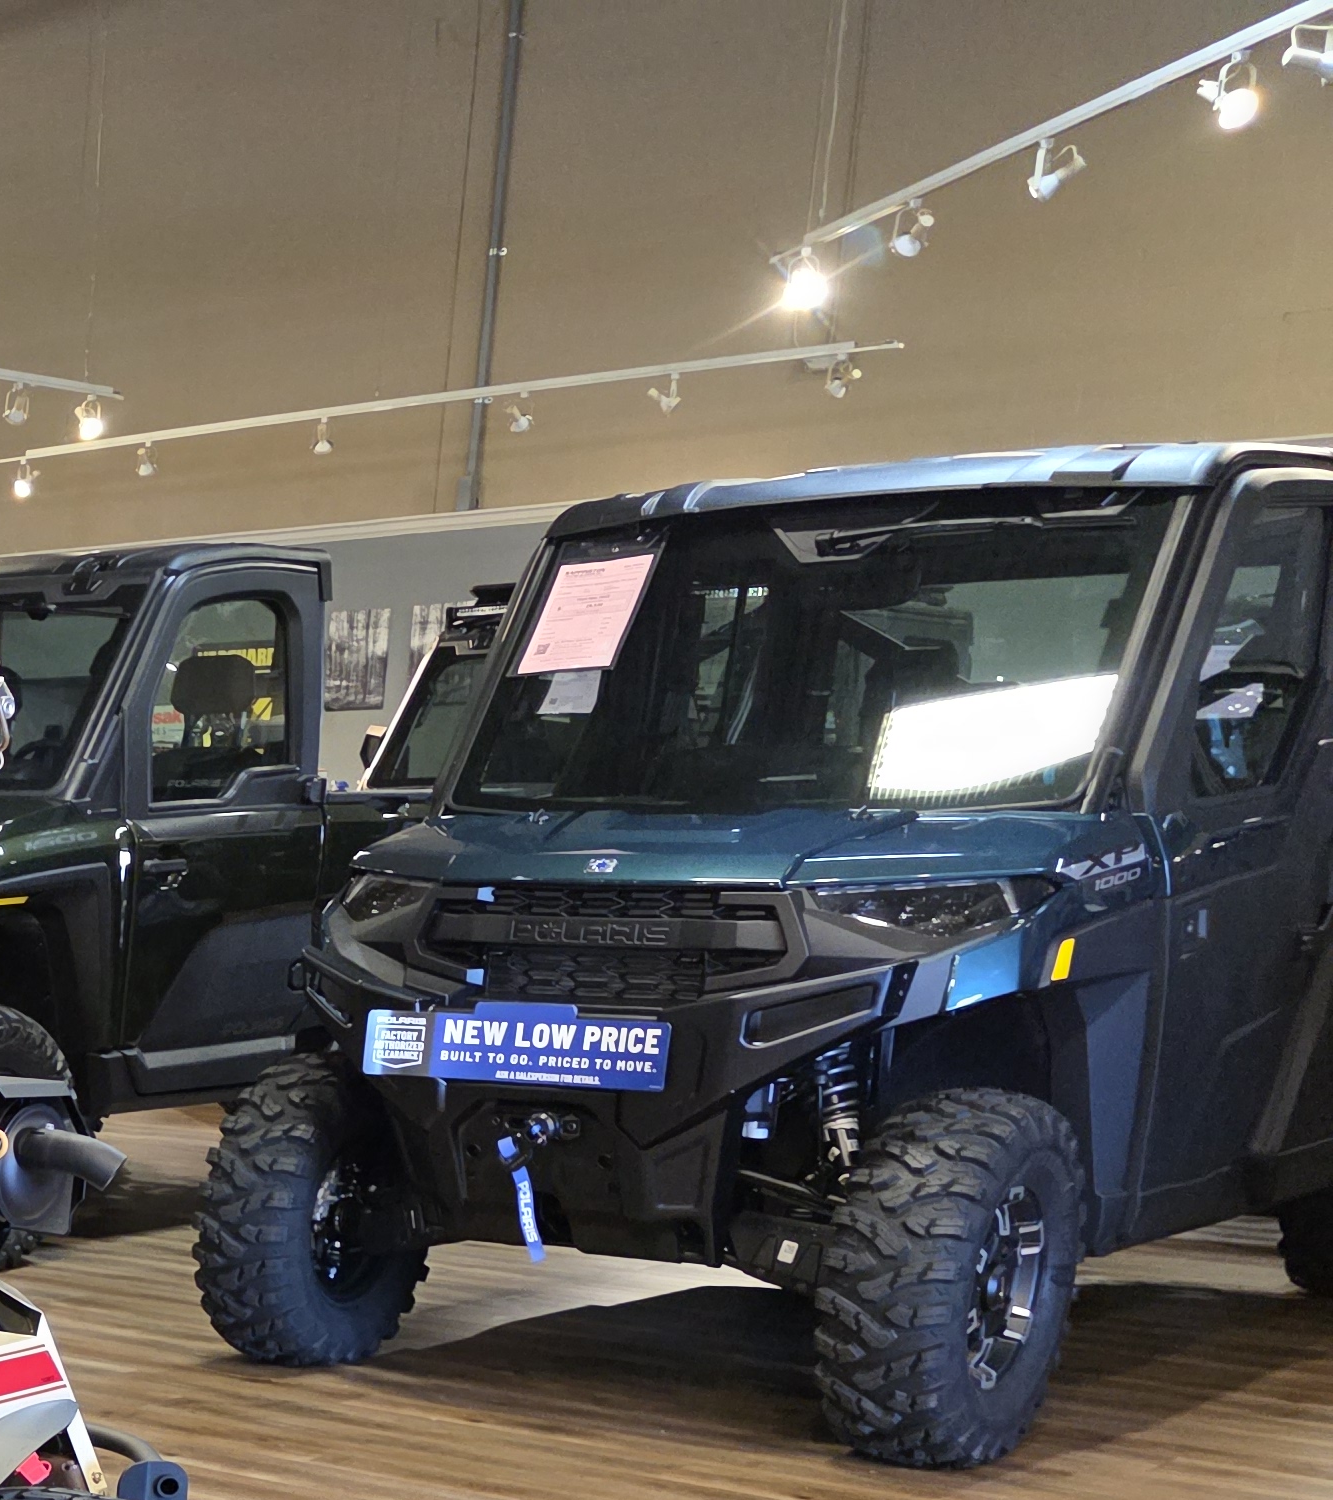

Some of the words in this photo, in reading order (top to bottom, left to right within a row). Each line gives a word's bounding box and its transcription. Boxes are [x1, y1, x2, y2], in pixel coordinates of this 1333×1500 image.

[1094, 867, 1141, 891] 1000
[509, 919, 670, 946] POLARIS
[373, 1040, 425, 1051] AUTHORIZED
[380, 1030, 419, 1041] FACTORY
[443, 1018, 509, 1047] NEW
[514, 1023, 577, 1050] LOW
[582, 1025, 662, 1055] PRICE
[439, 1049, 483, 1063] BUILT
[487, 1052, 505, 1065] TO
[509, 1053, 533, 1066] GO.
[538, 1055, 590, 1069] PRICED
[594, 1058, 611, 1071] TO
[616, 1060, 658, 1073] MOVE.
[518, 1180, 538, 1243] POLARIS
